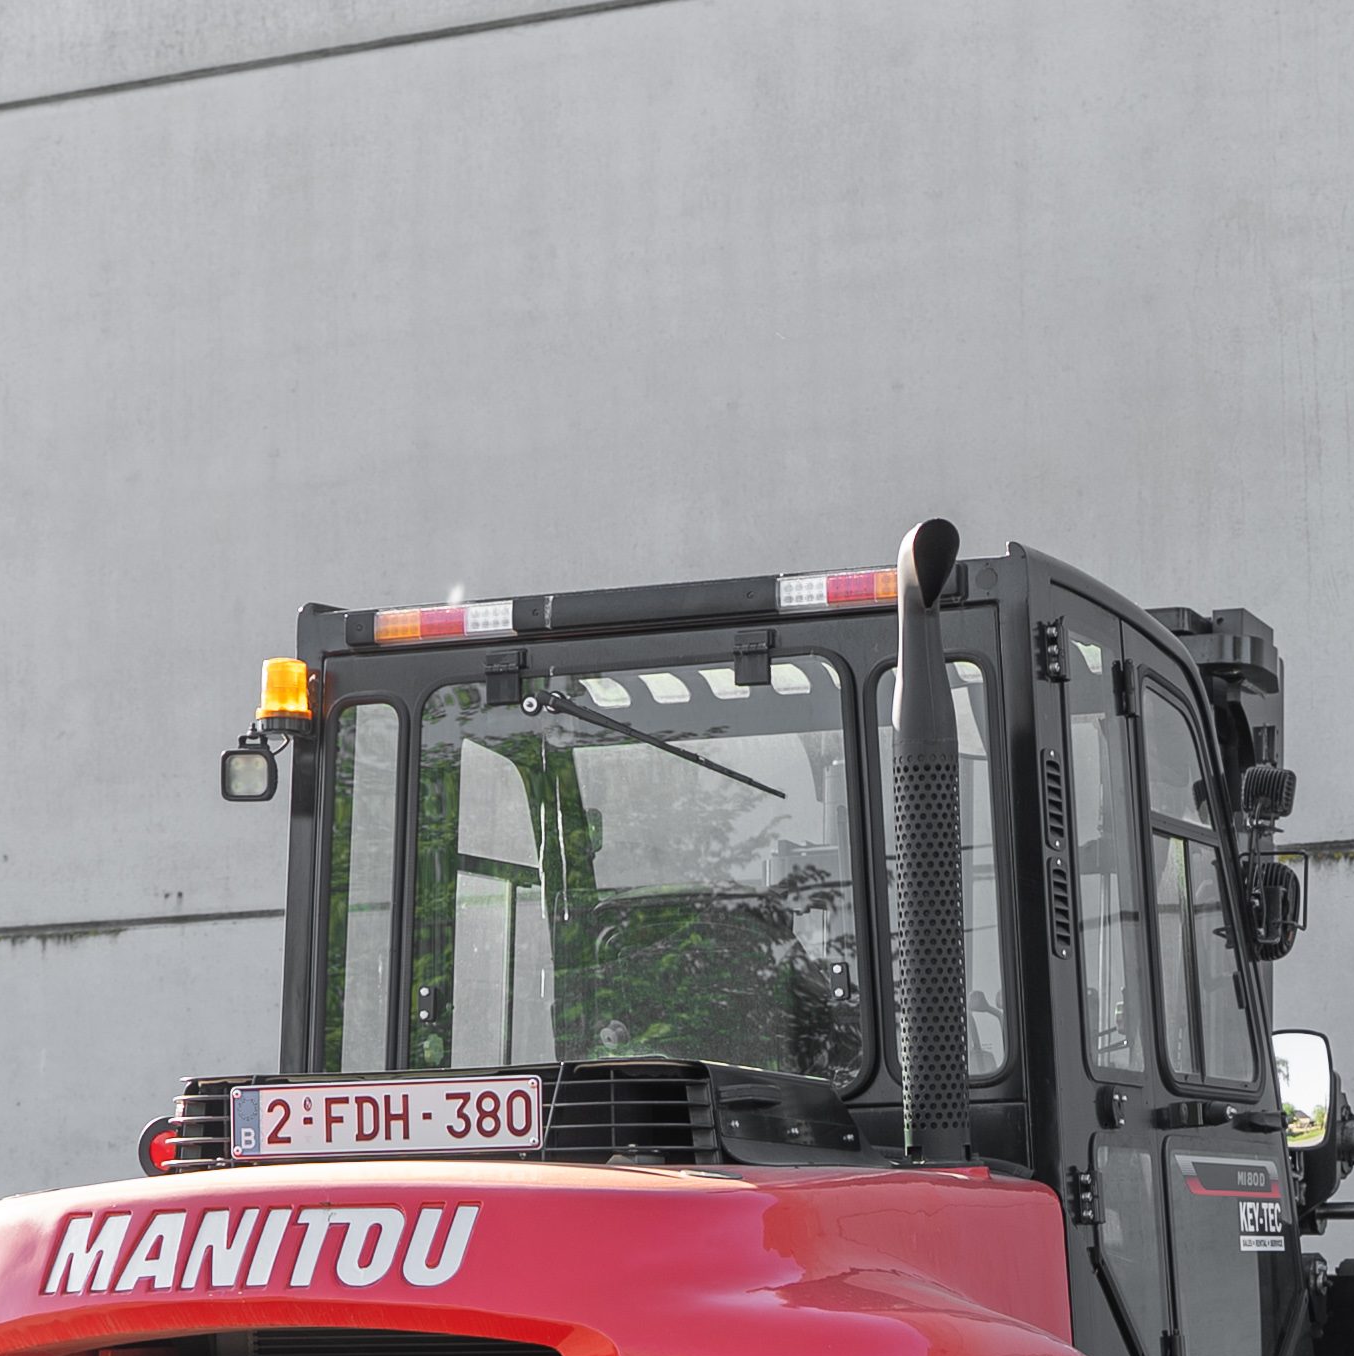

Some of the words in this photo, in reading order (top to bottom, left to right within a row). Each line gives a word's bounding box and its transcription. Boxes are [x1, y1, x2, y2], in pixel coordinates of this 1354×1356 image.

[241, 1127, 256, 1149] B
[1239, 1201, 1282, 1232] KEY-TEC
[43, 1204, 481, 1294] MANITOU
